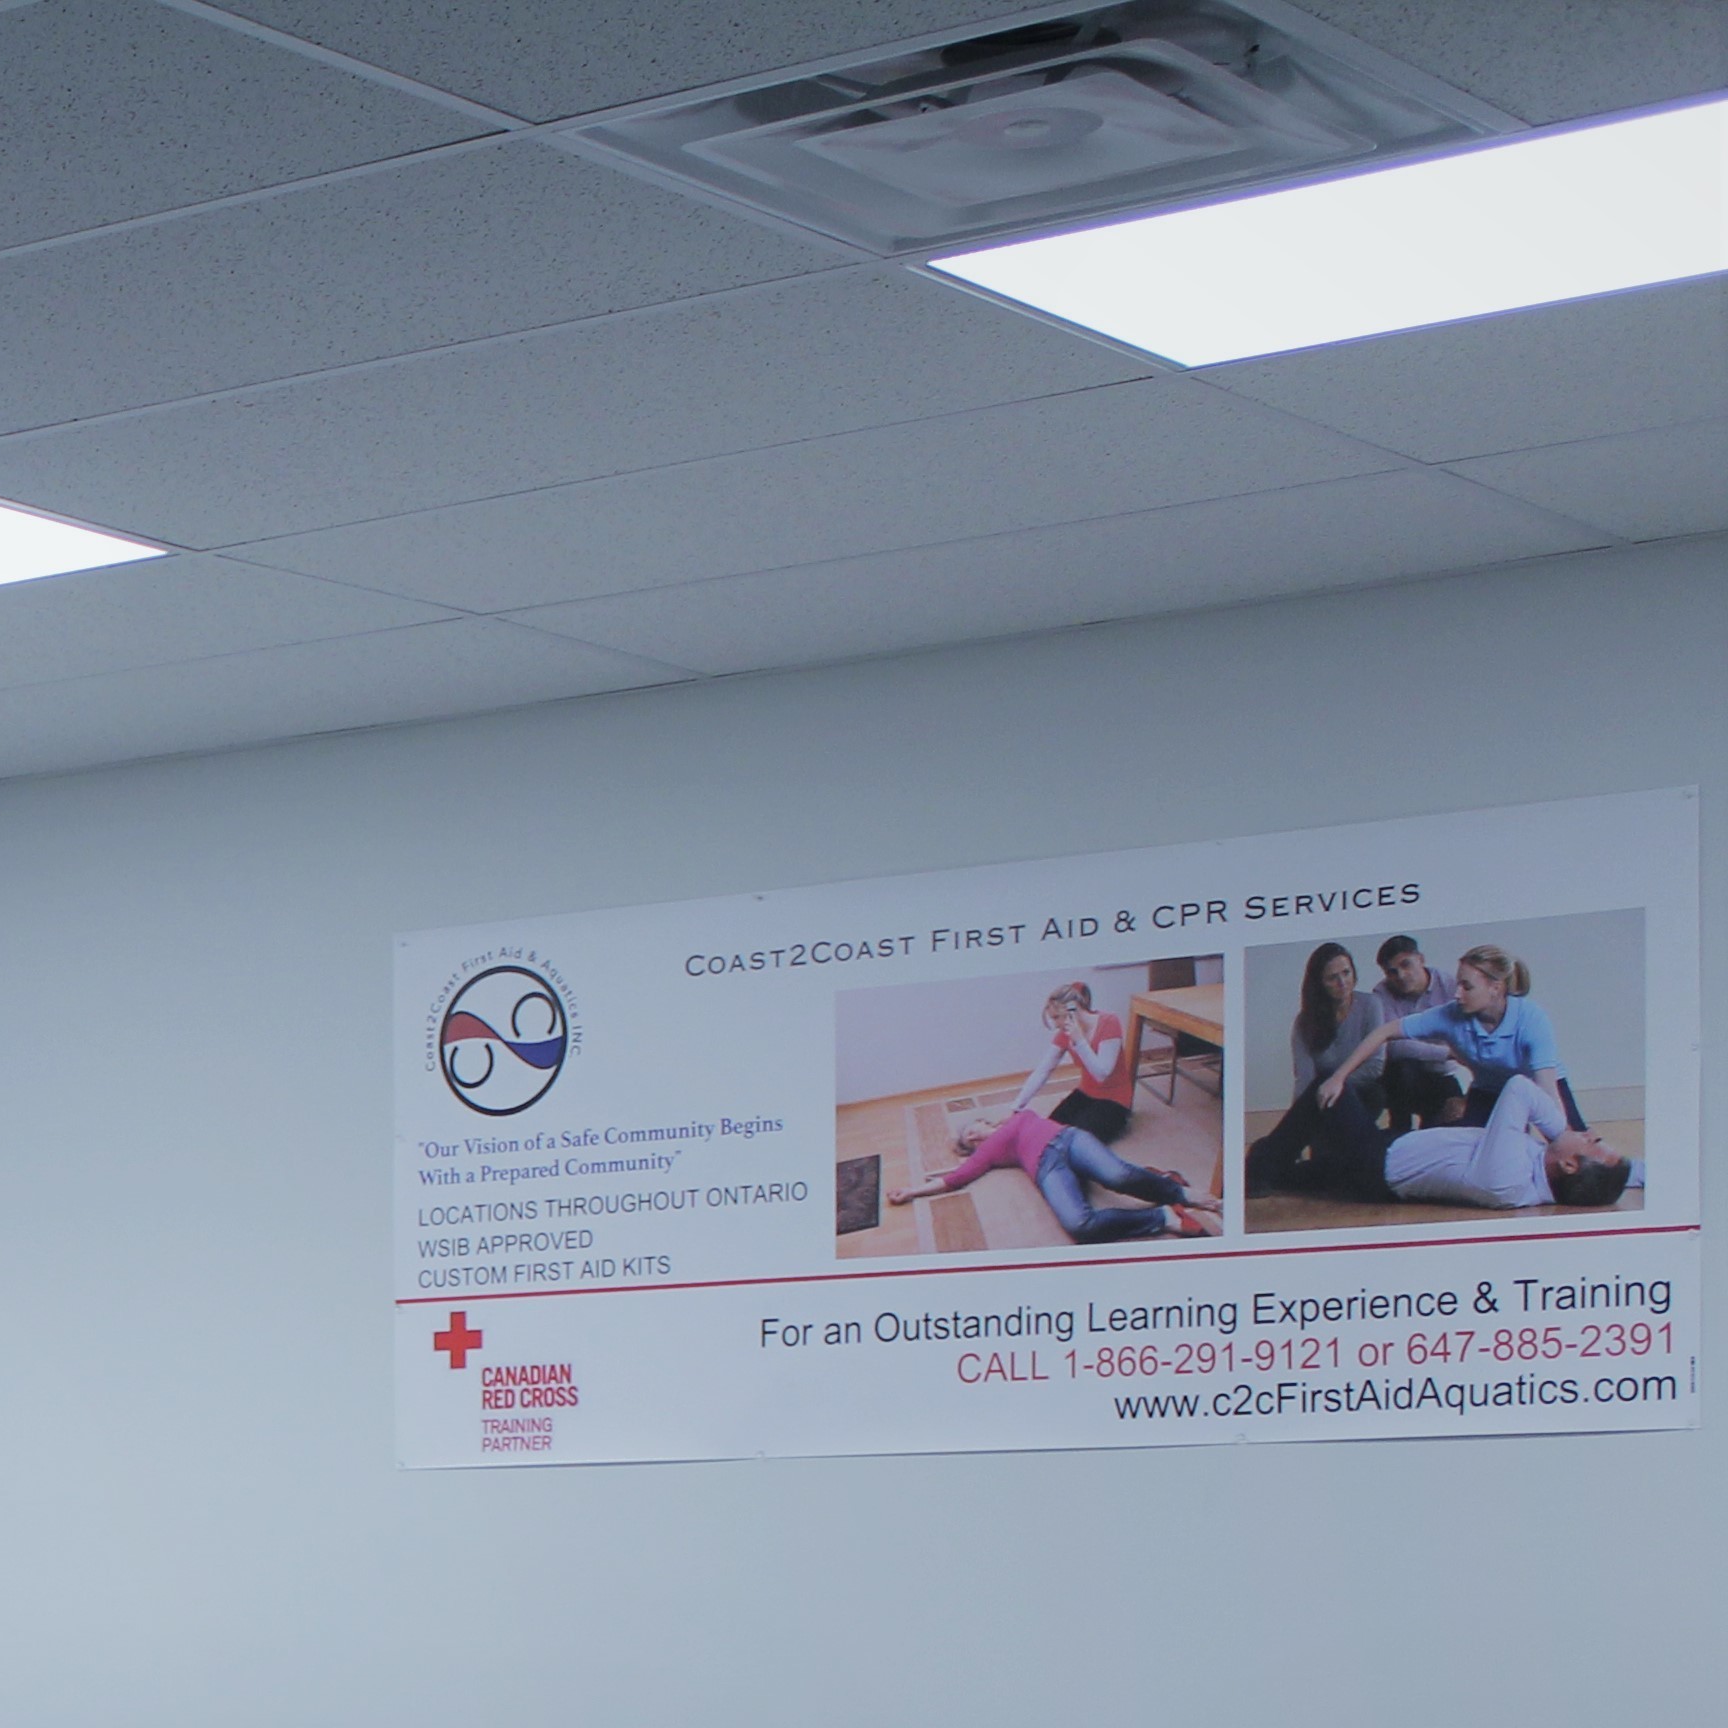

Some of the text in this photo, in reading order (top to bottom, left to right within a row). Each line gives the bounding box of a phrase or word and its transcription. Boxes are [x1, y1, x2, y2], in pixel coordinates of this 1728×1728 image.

[1114, 910, 1137, 933] &
[1152, 900, 1228, 929] CPR
[425, 973, 460, 1072] Coast2Coast
[461, 951, 493, 972] First
[499, 947, 523, 959] Aid
[527, 951, 537, 962] &
[541, 959, 578, 1019] Aquatics
[465, 1137, 520, 1156] Vision
[524, 1132, 546, 1152] of
[546, 1138, 556, 1150] a
[561, 1130, 600, 1149] Safe
[604, 1119, 715, 1145] Community
[721, 1116, 783, 1139] Begins
[418, 1167, 461, 1187] With
[465, 1172, 475, 1184] a
[481, 1160, 559, 1186] Prepared
[418, 1181, 808, 1227] LOCATIONS THROUGHOUT ONTARIO
[418, 1230, 594, 1258] WSIB APPROVED
[418, 1256, 671, 1289] CUSTOM FIRST AID KITS
[760, 1274, 1671, 1348] For an Outstanding Learning Experience & Training
[956, 1321, 1674, 1384] CALL 1-866-291-9121 or 647-885-2391
[482, 1363, 572, 1387] CANADIAN
[482, 1386, 579, 1410] RED CROSS
[1115, 1373, 1677, 1420] www.c2cFirstAidAquatics.com
[482, 1417, 553, 1434] TRAINING
[482, 1435, 552, 1452] PARTNER
